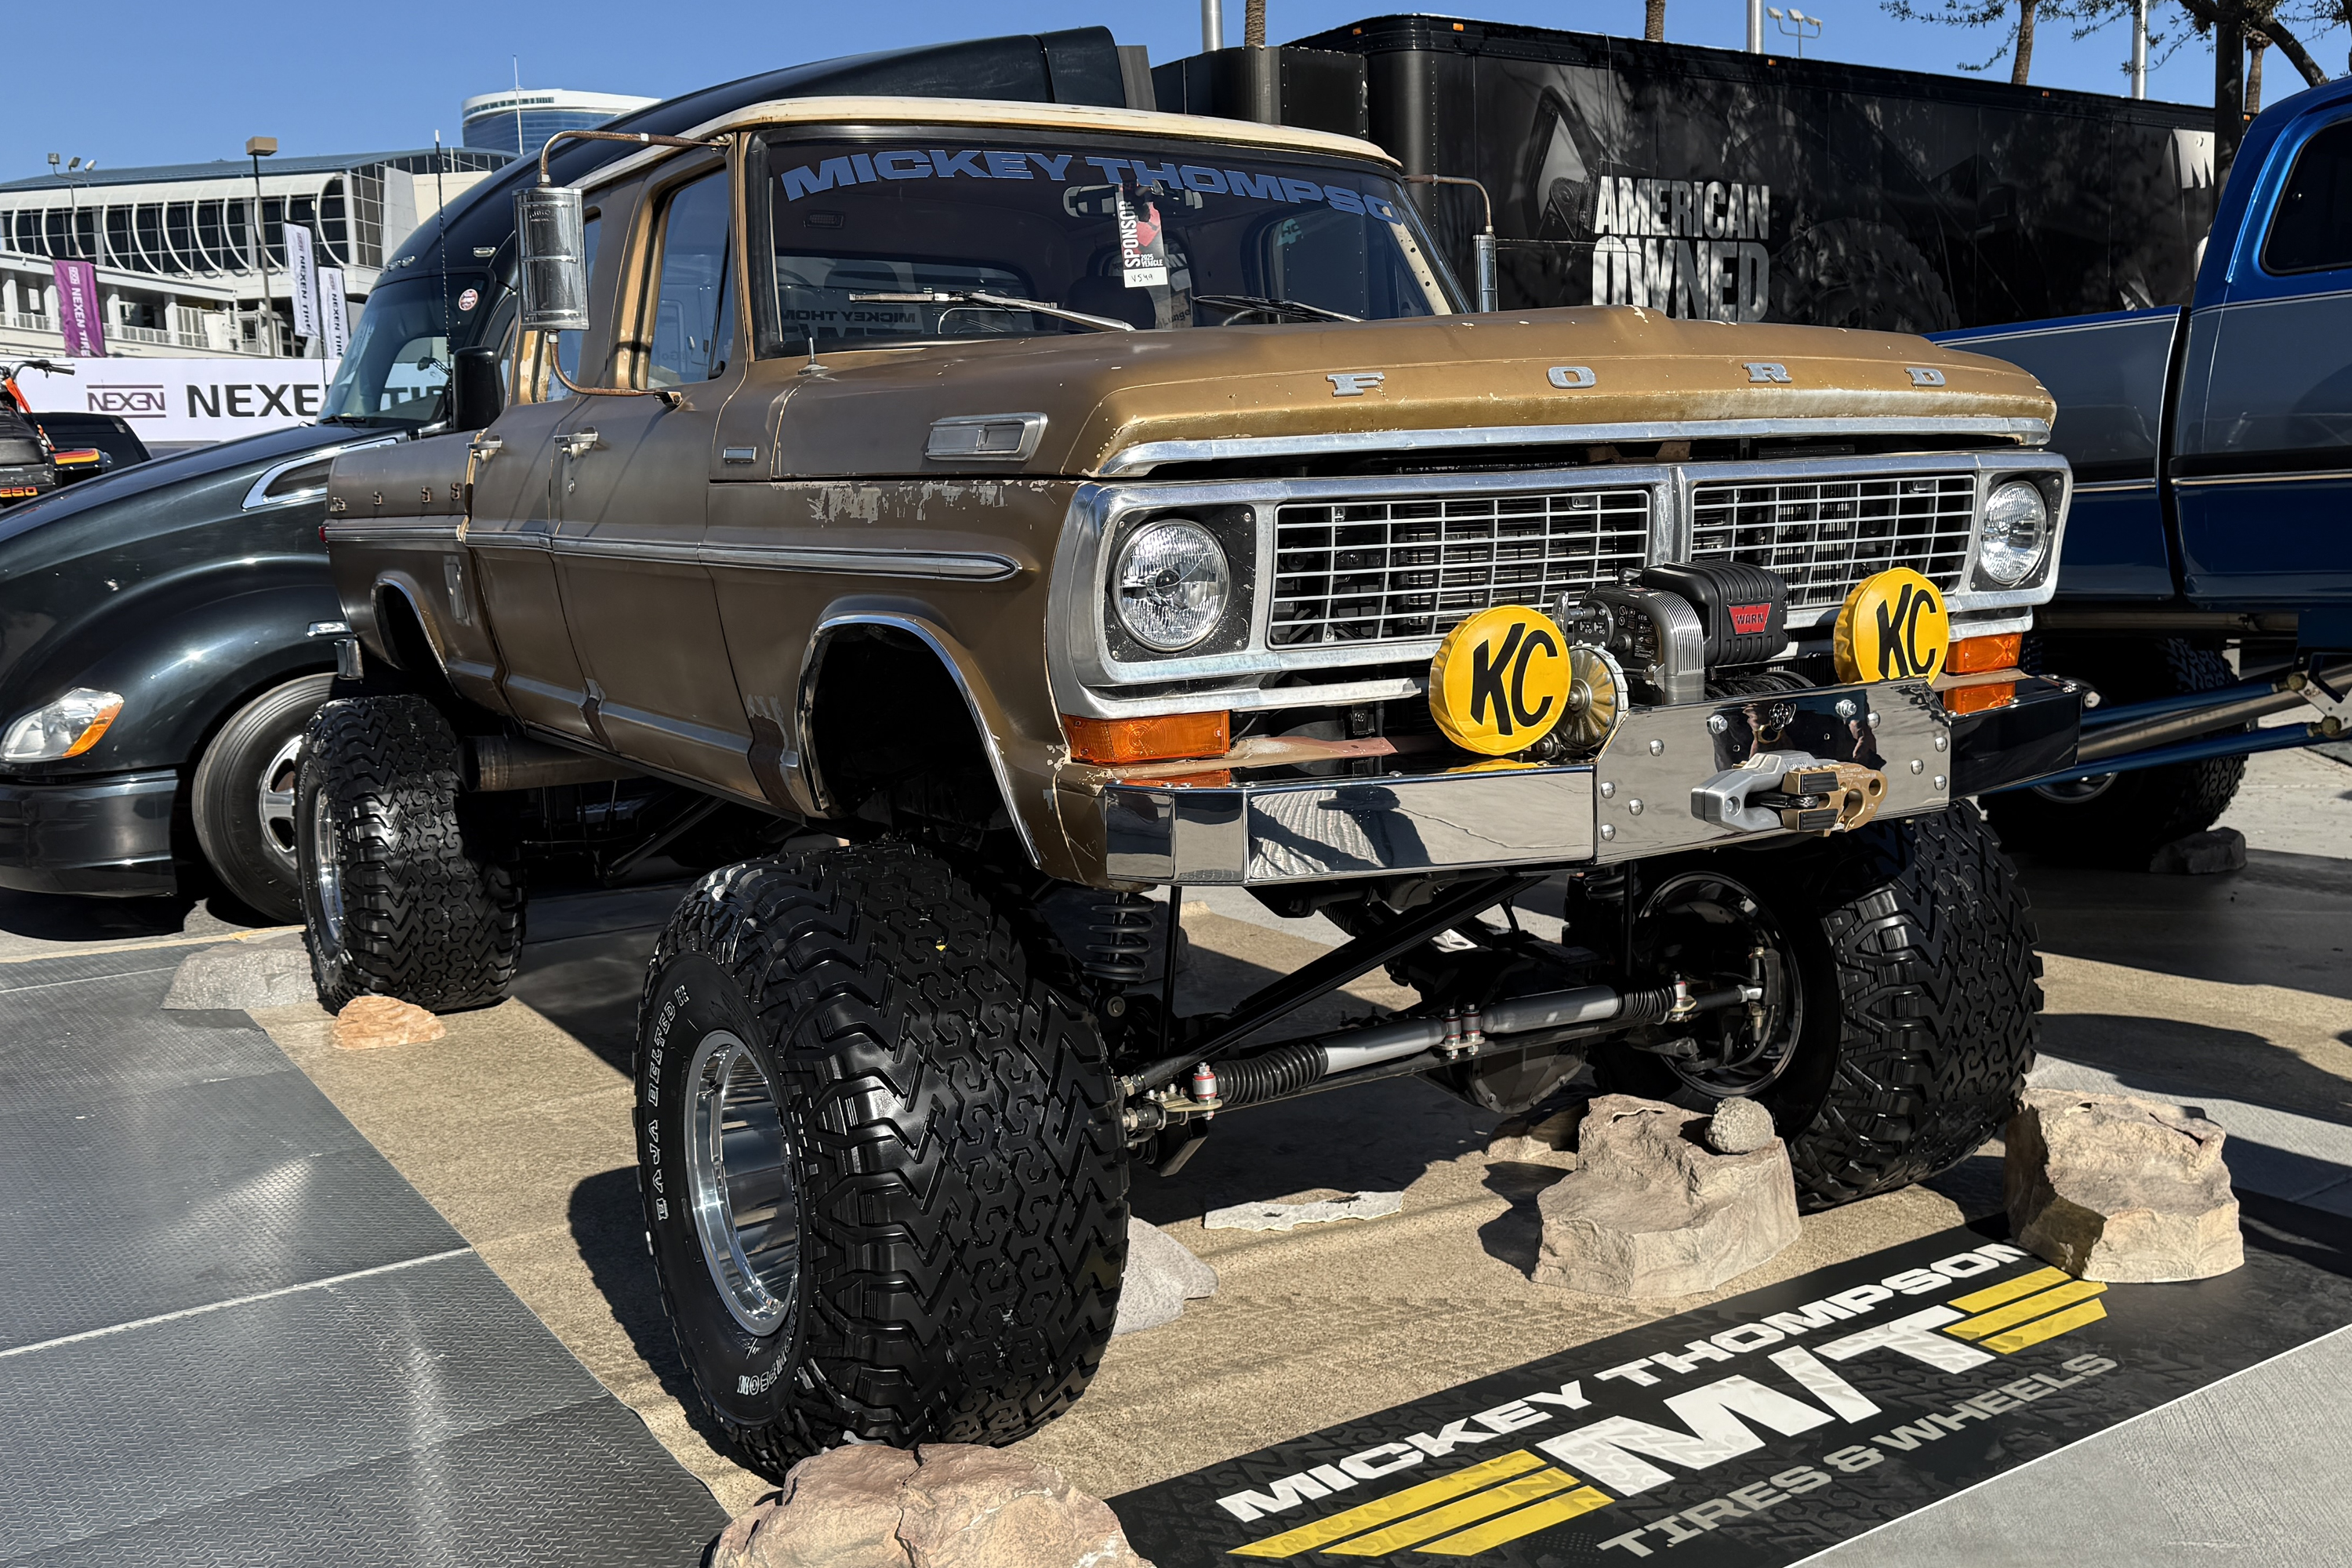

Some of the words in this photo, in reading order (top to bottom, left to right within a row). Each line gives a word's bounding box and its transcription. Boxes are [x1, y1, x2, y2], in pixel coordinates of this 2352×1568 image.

[781, 150, 1073, 201] MICKEY
[1119, 200, 1141, 267] SPONSOR
[1594, 176, 1769, 239] AMERICAN
[299, 256, 308, 299] NEXEN
[1592, 236, 1769, 321] OWNED
[71, 287, 85, 328] NEXEN
[332, 293, 341, 331] NEXEN
[186, 384, 320, 418] NEXE
[1326, 361, 1946, 397] FORD
[0, 486, 38, 498] 250
[1736, 612, 1764, 626] WARN
[1875, 583, 1937, 679] KC
[1470, 622, 1558, 736] KC
[648, 1120, 669, 1221] BAJA
[1216, 1380, 1592, 1523] MICKEY
[1594, 1243, 2031, 1387] THOMPSON
[1596, 1465, 1832, 1558] TIRES
[1823, 1445, 1885, 1474] &
[1871, 1354, 2118, 1452] WHEELS
